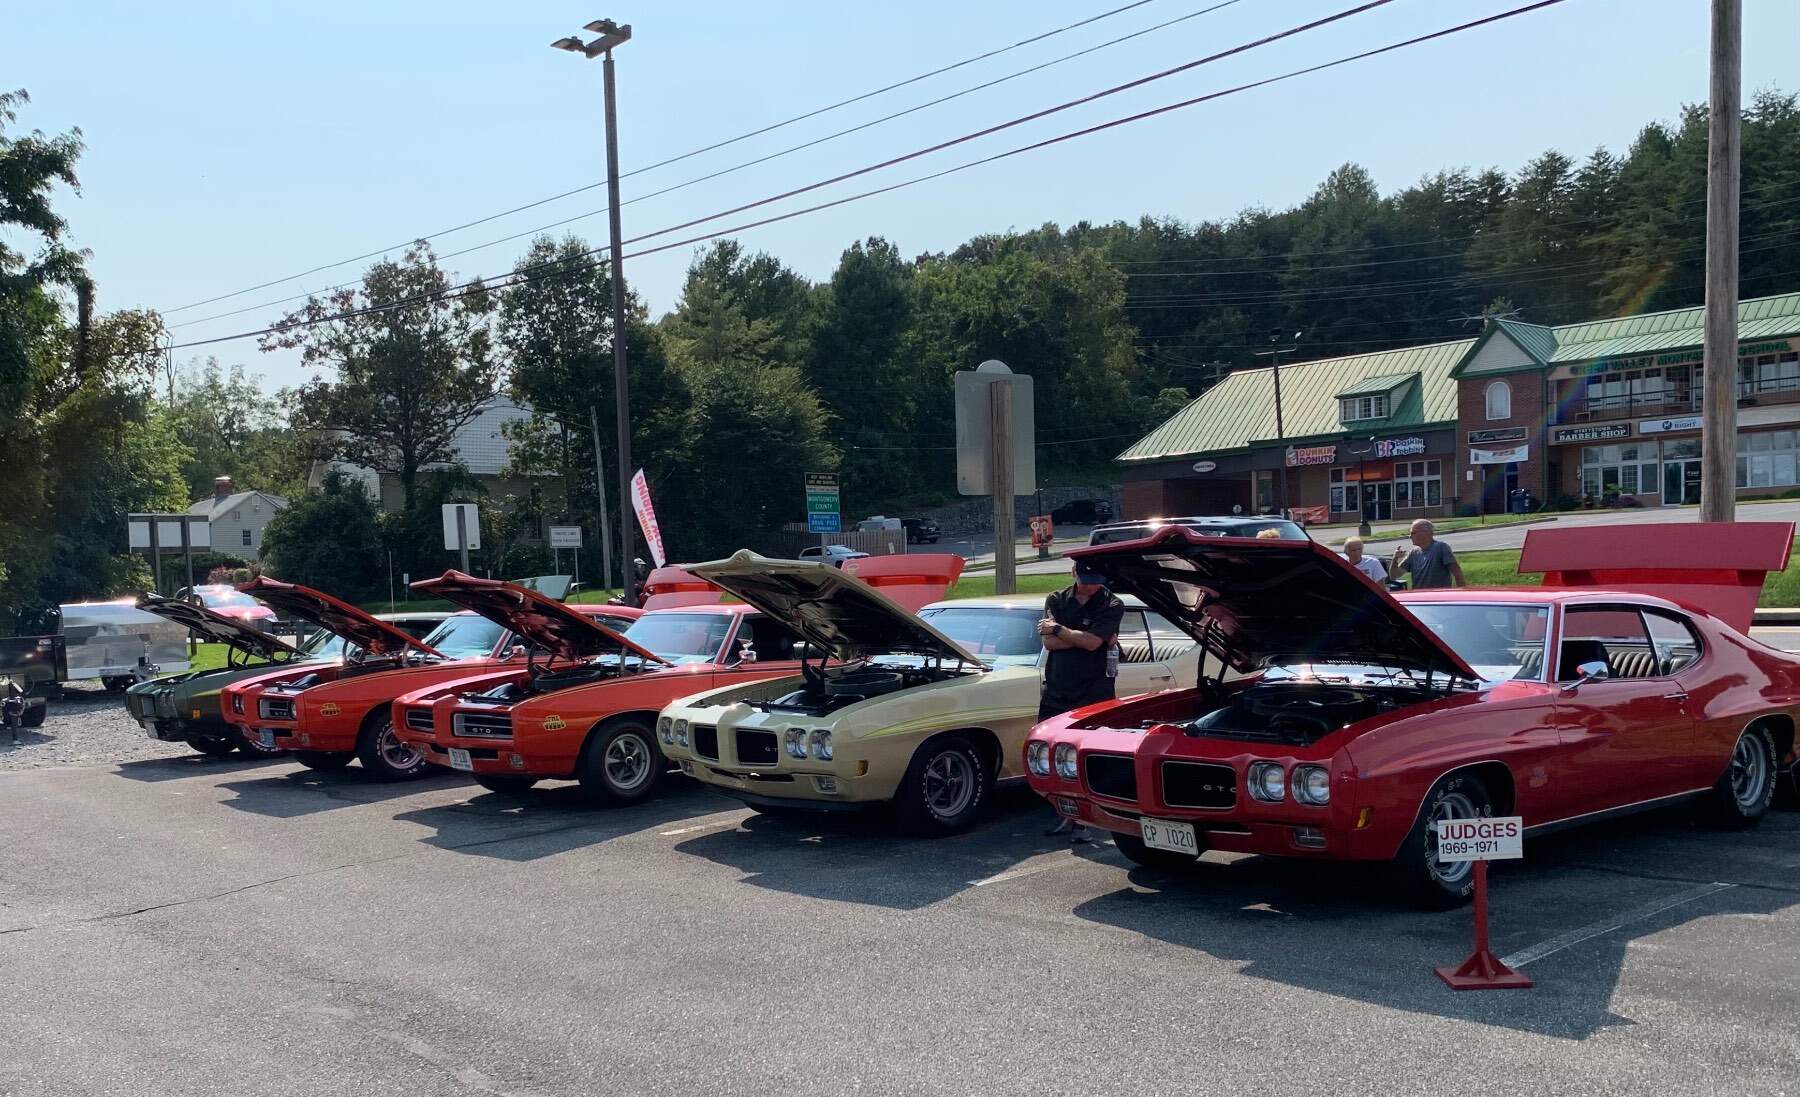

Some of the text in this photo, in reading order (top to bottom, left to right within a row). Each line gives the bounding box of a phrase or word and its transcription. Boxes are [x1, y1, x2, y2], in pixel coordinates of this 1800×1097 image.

[1559, 432, 1599, 441] BARBER
[1600, 429, 1626, 438] SHOP
[1299, 455, 1335, 465] DONUTS
[635, 475, 656, 521] HIRING
[1143, 824, 1194, 848] CP 1020
[1440, 822, 1518, 840] JUDGES
[1440, 841, 1498, 855] 1969-1971
